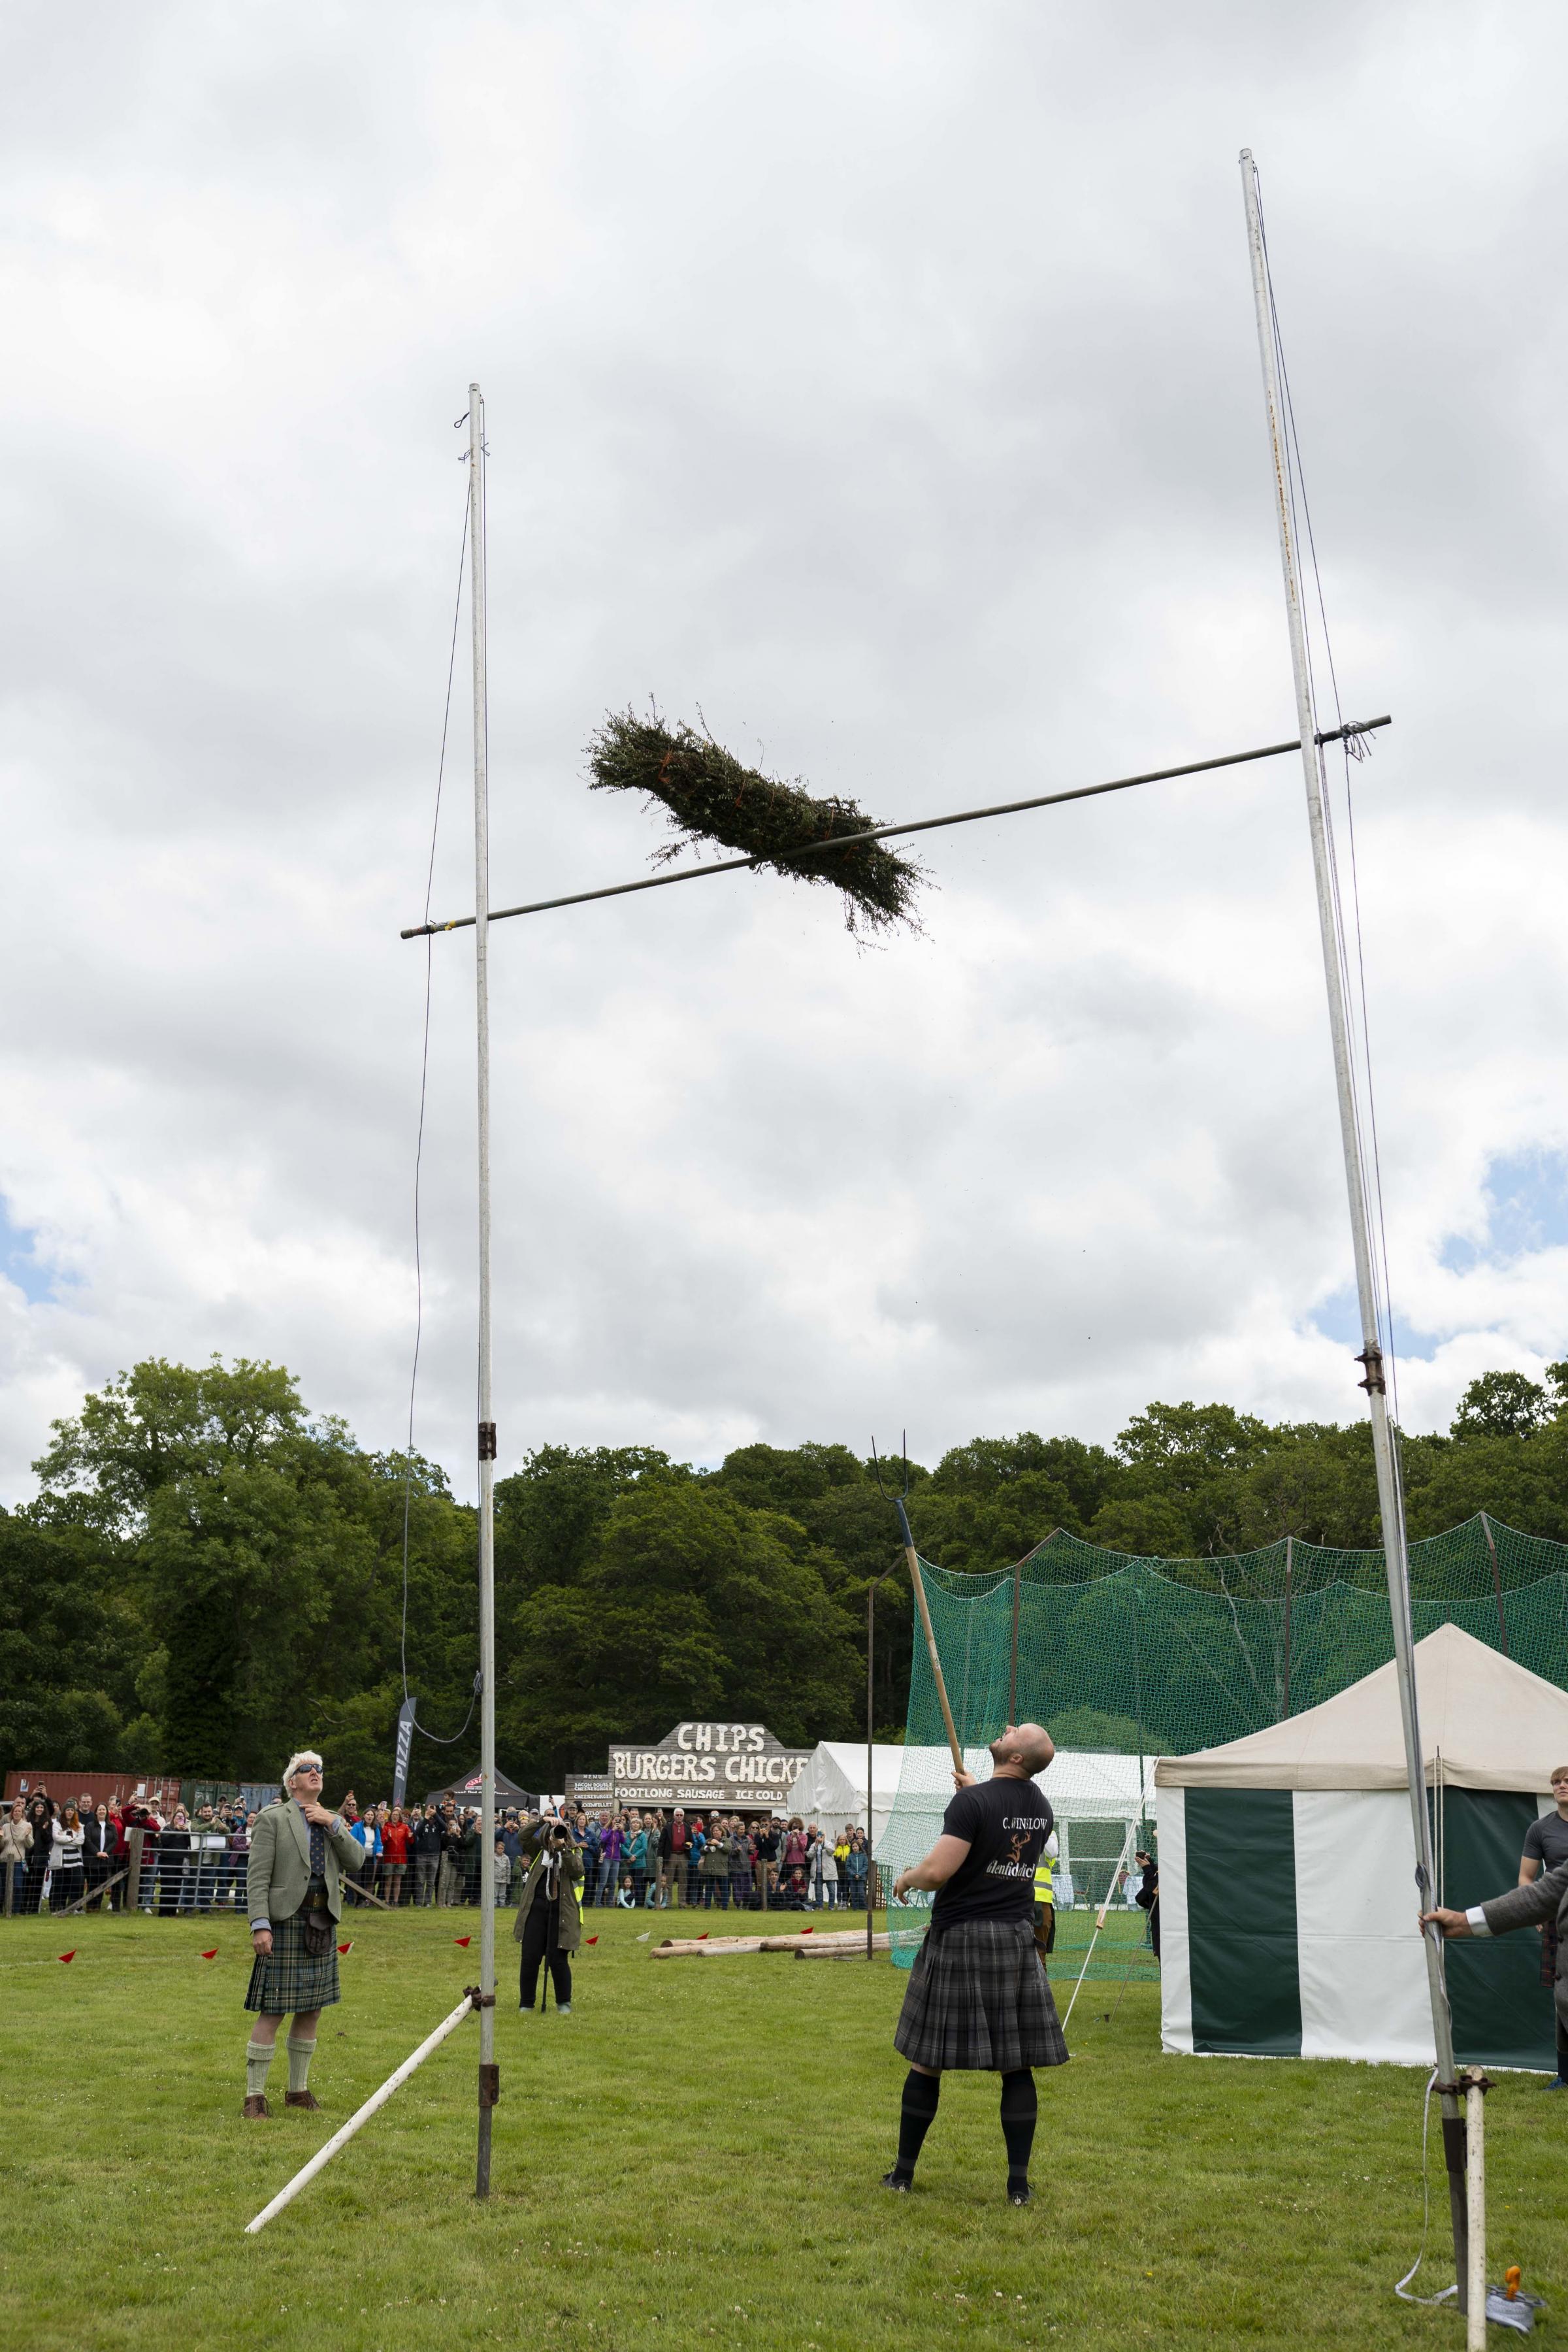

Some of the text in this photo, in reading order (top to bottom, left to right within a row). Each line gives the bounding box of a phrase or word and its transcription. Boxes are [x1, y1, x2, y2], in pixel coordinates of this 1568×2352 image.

[395, 1720, 412, 1782] PIZZA
[678, 1724, 764, 1752] CHIPS
[613, 1752, 716, 1782] BURGERS
[615, 1788, 672, 1798] FOOTLONG
[677, 1788, 725, 1799] SAUSAGE
[736, 1789, 753, 1799] ICE
[756, 1791, 783, 1800] COLD
